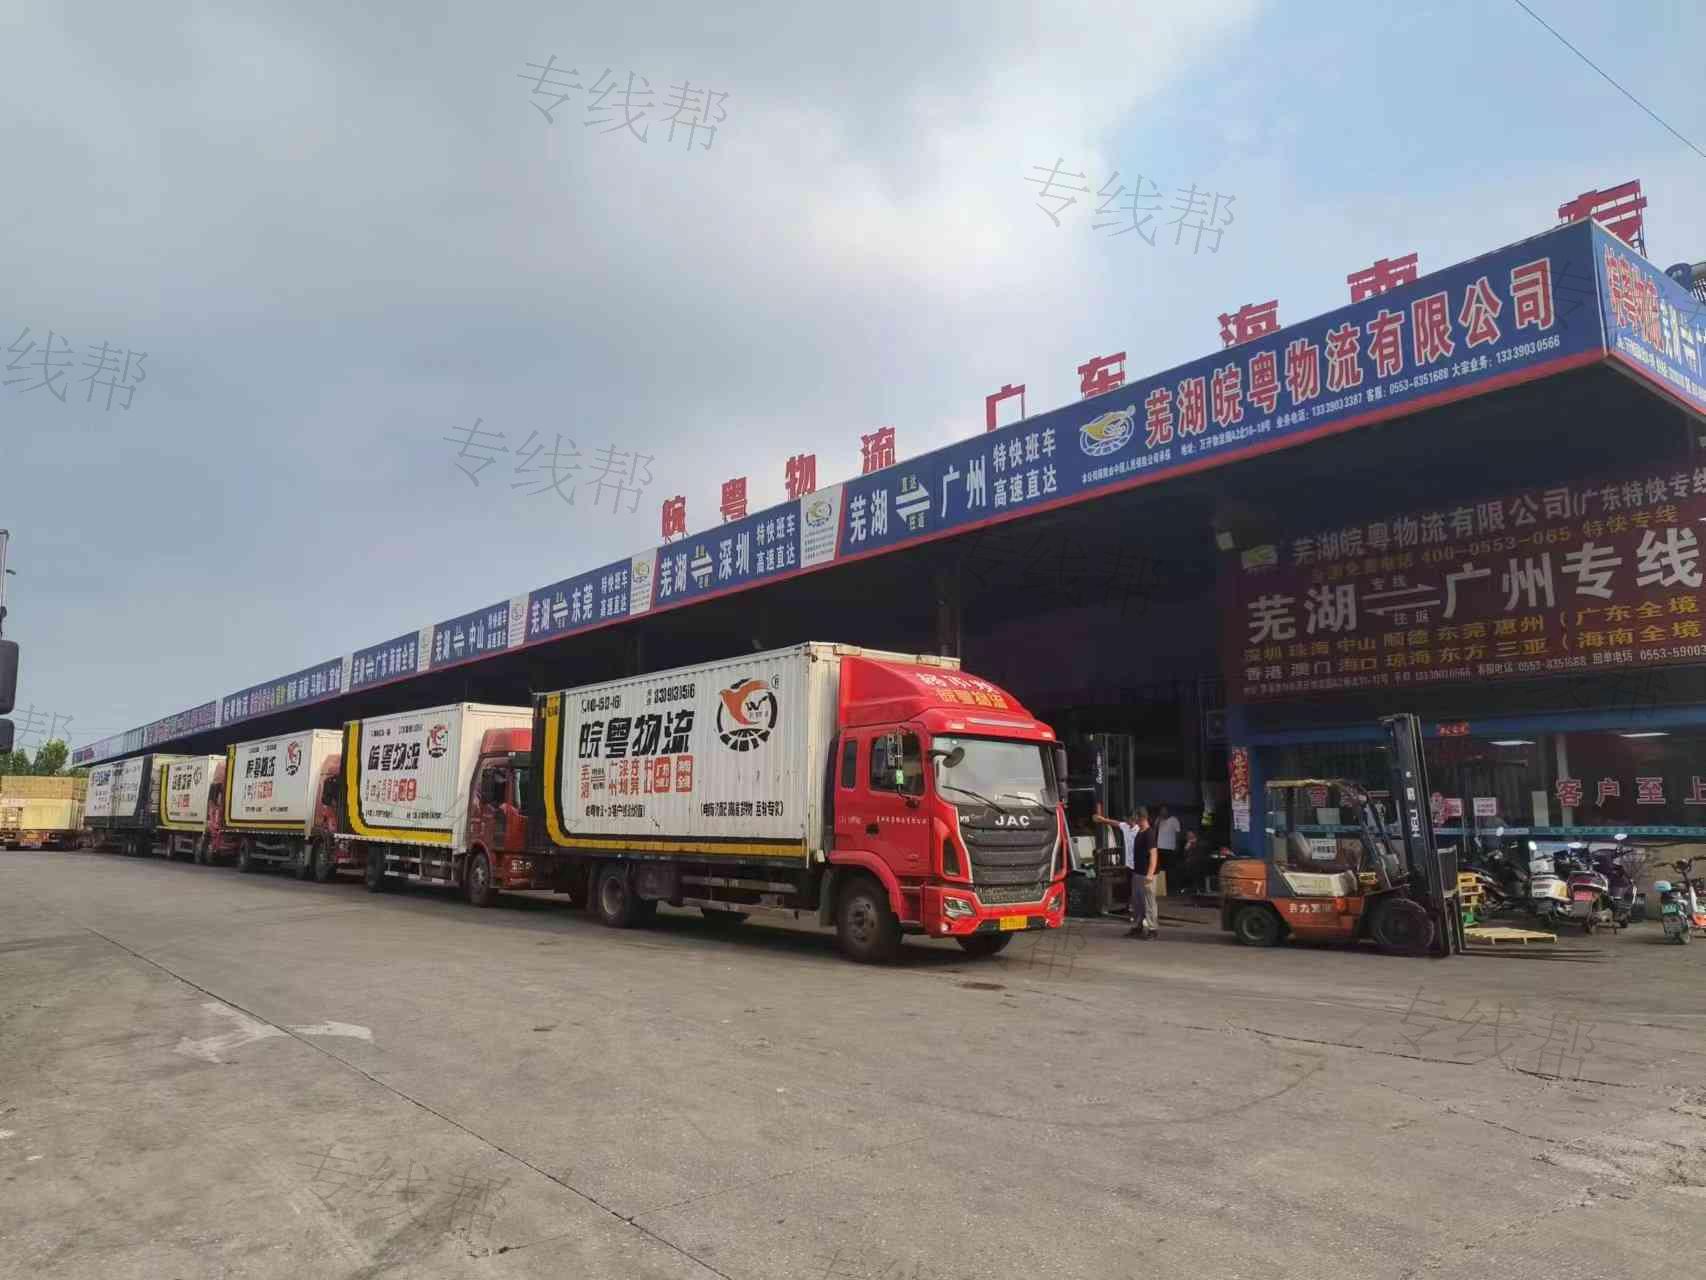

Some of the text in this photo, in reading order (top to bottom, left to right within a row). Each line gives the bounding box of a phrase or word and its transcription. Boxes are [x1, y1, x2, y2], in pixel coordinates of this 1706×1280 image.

[1145, 256, 1556, 449] 芜湖皖粤物流有限公司
[992, 427, 1058, 473] 特快班车
[849, 488, 888, 545] 芜湖
[941, 455, 987, 519] 广州
[993, 465, 1058, 508] 高速直达
[756, 513, 796, 546] 特快班车
[659, 553, 688, 598] 芜湖
[718, 531, 750, 582] 深圳
[756, 543, 796, 575] 高速直达
[530, 583, 593, 635] 芜湖 东莞
[1248, 584, 1358, 644] 芜湖
[1495, 615, 1544, 636] 惠州
[579, 708, 696, 759] 皖粤物流
[994, 815, 1031, 827] JAC
